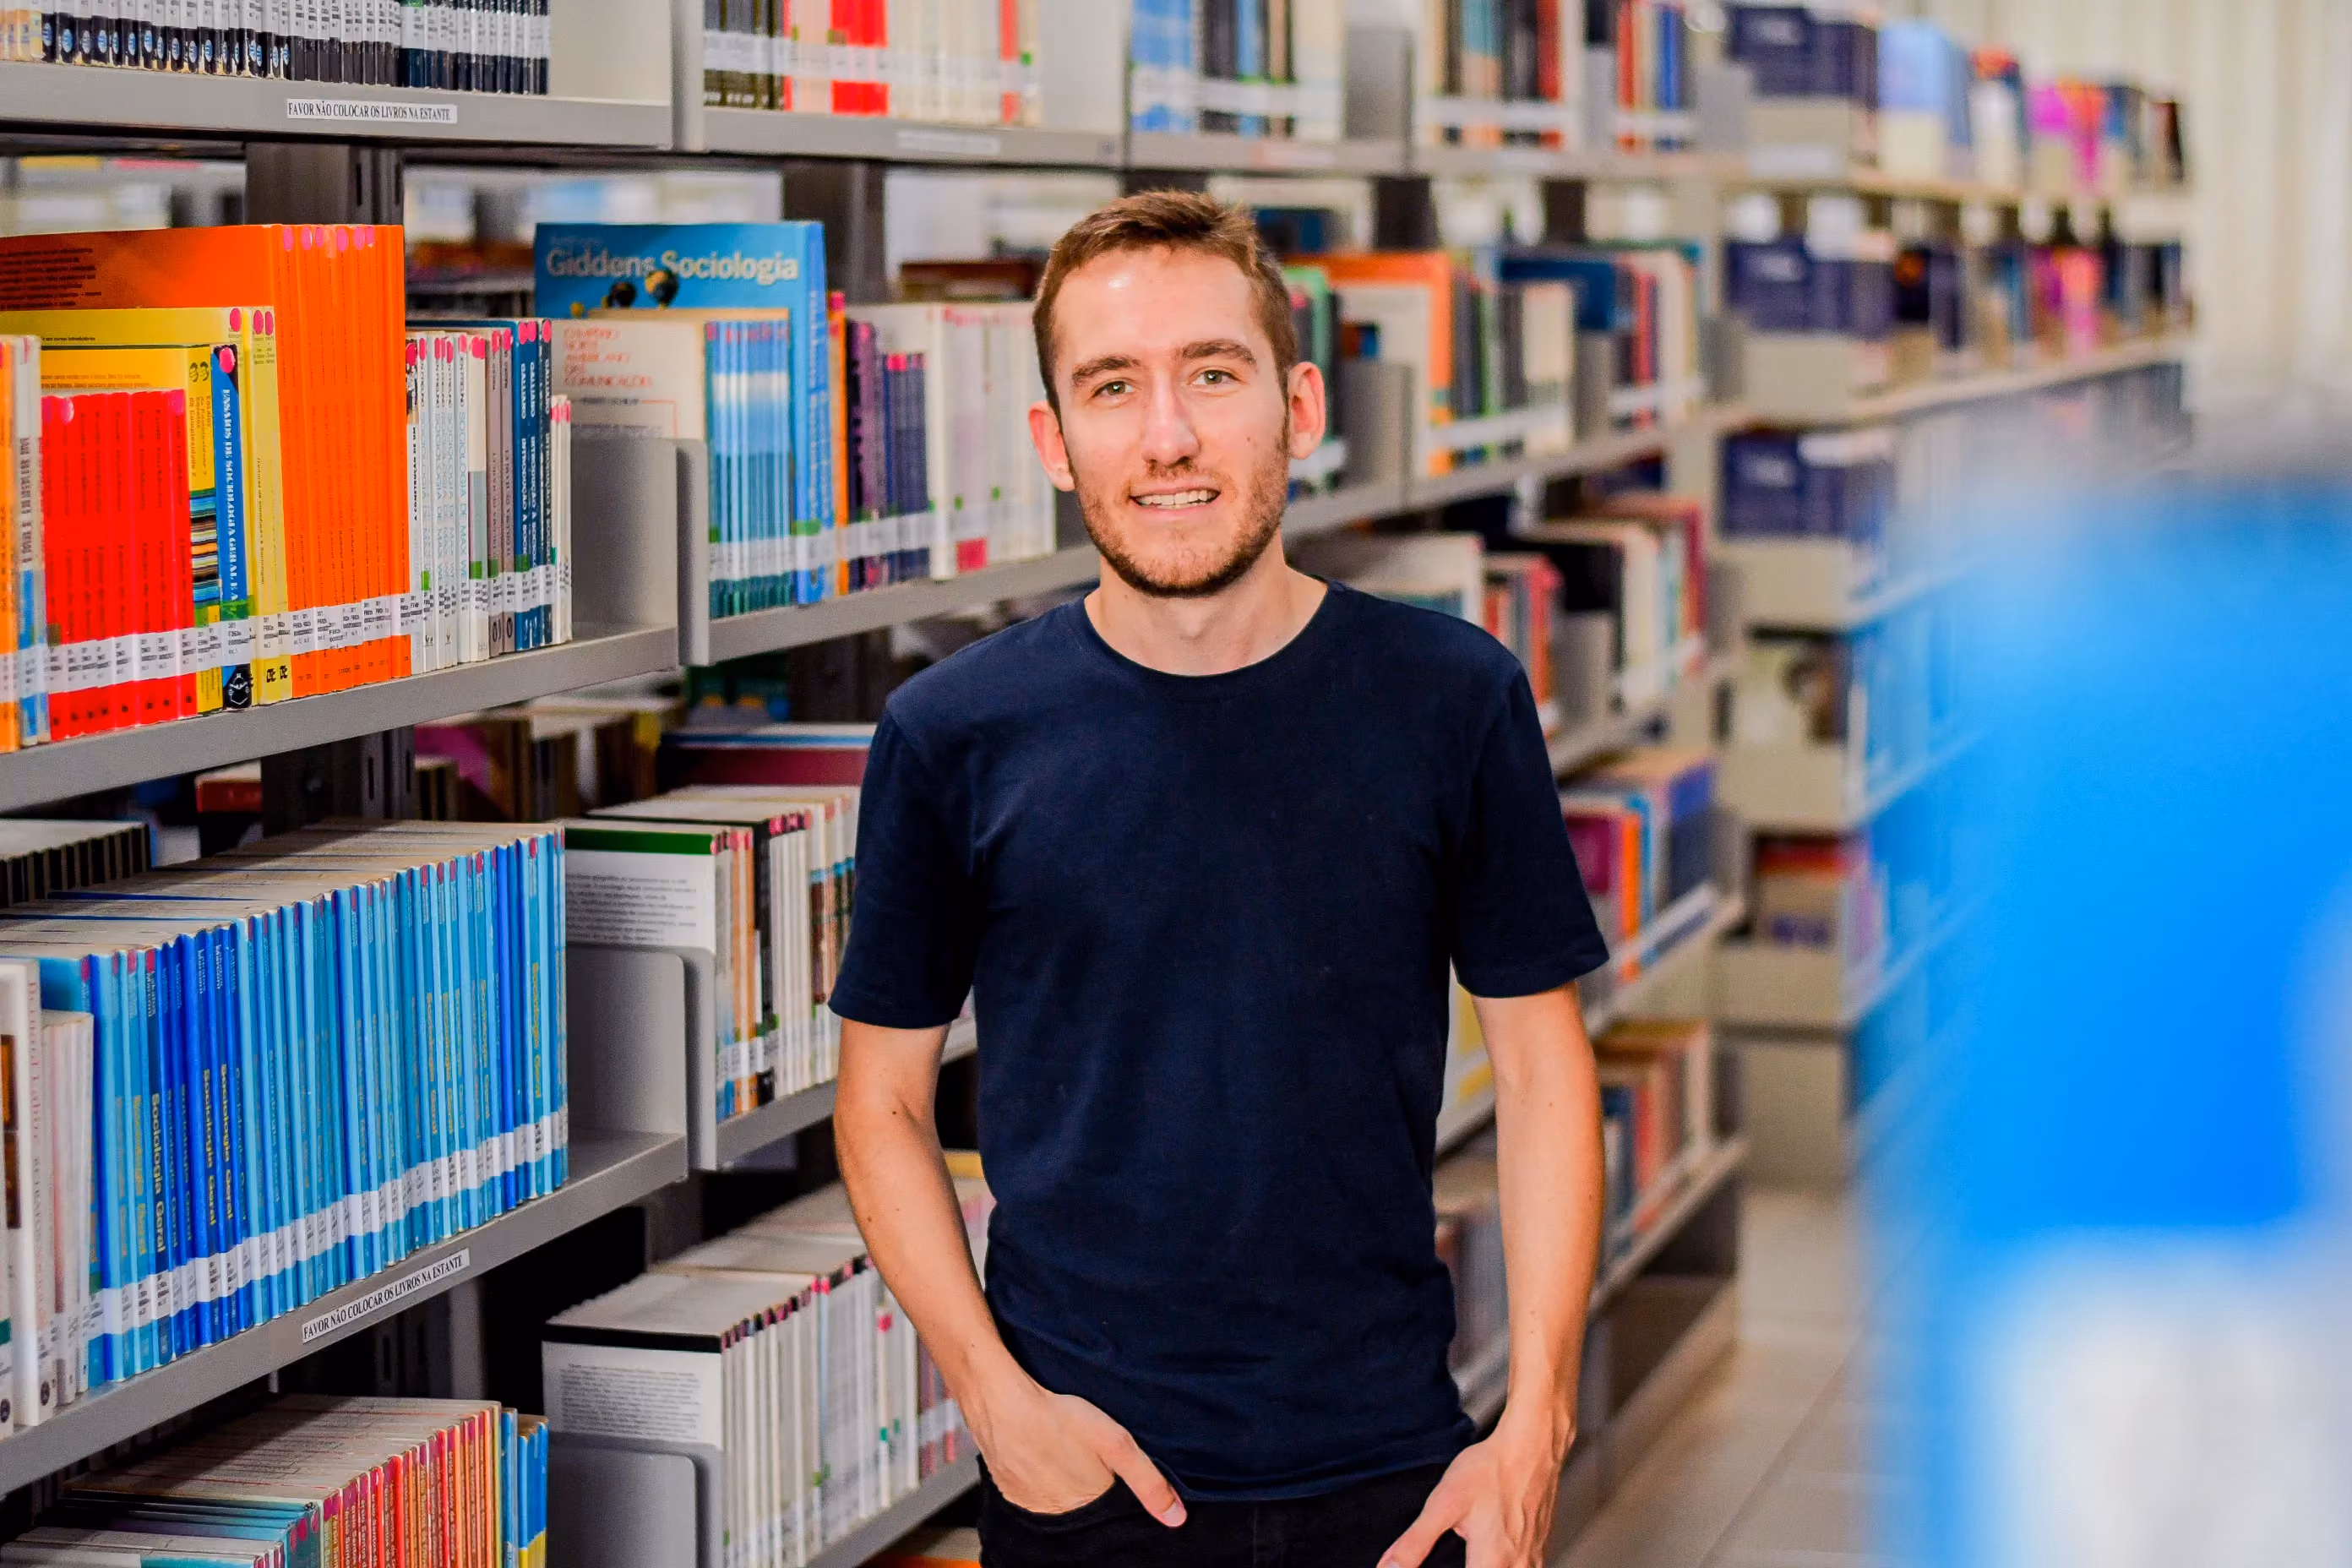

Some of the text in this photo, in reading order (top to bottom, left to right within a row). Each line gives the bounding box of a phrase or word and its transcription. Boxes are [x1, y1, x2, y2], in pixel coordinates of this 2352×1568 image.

[288, 101, 450, 121] FAVOR NÃO COLOCAR OS LIVROS NA ESTANTE
[547, 247, 799, 286] Giddens Sociologia
[222, 389, 233, 440] ENSAIOS
[412, 426, 416, 441] UM
[223, 441, 234, 459] DE
[412, 442, 416, 455] DE
[458, 411, 467, 498] SOCIOLOGIA
[520, 438, 529, 511] INTRODUÇÃO
[225, 460, 237, 536] SOCIOLOGIA
[459, 503, 467, 522] DE
[227, 537, 238, 580] GERAL
[531, 962, 540, 1050] Sociologia
[151, 1092, 166, 1253] Sociologia Geral
[204, 1069, 217, 1227] Sociologia Geral
[220, 1063, 234, 1220] Sociologia Geral
[302, 1255, 463, 1340] FAVOR NÃO COLOCAR OS LIVROS NA ESTANTE
